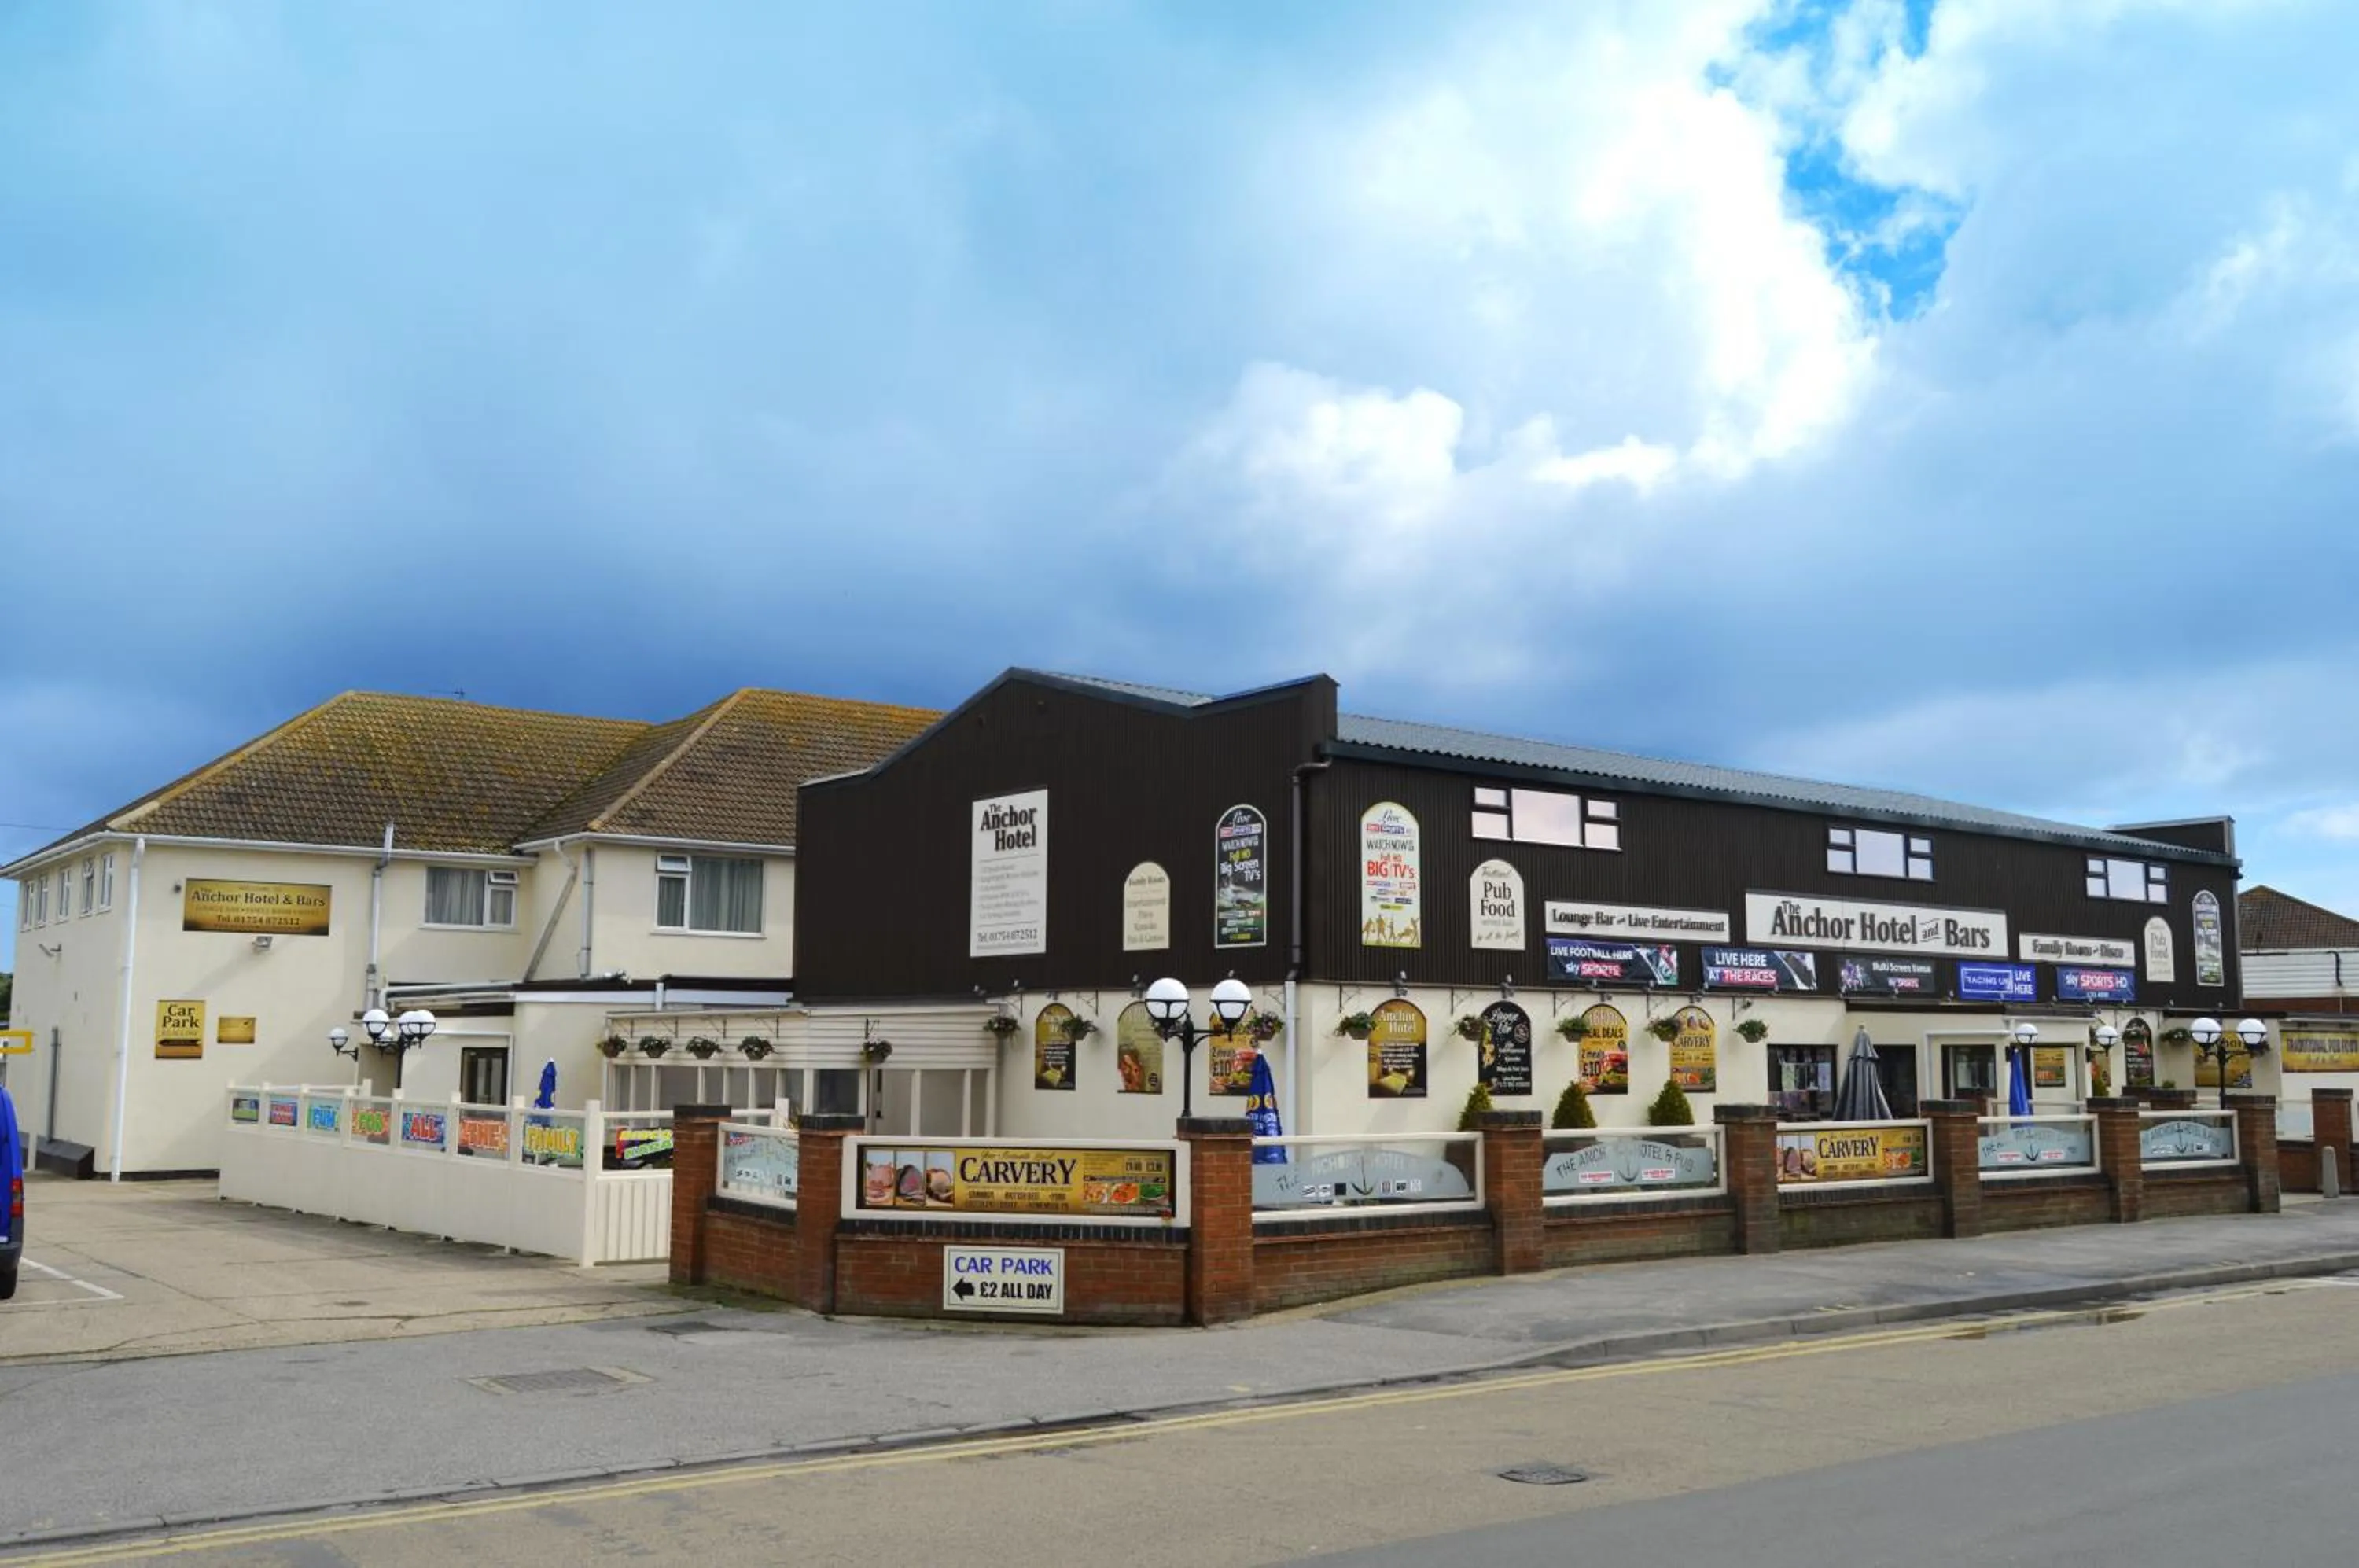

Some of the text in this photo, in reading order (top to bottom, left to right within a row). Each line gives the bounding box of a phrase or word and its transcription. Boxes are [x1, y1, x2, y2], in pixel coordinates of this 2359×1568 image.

[989, 803, 1002, 813] The
[981, 805, 1037, 831] Anchor
[995, 824, 1036, 852] Hotel
[1367, 861, 1415, 879] BIG TV's
[1484, 881, 1512, 900] Pub
[191, 890, 326, 907] Anchor Hotel & Bars
[1481, 899, 1515, 918] Food
[1781, 900, 1801, 914] The
[1552, 908, 1725, 932] Lounge Bar Live Entertainment
[1771, 906, 1990, 948] Anchor Hotel and Bars
[1551, 946, 1633, 960] LIVE FOOTBALL HERE
[2033, 939, 2063, 958] Family
[1715, 952, 1767, 967] LIVE HERE
[1566, 963, 1621, 977] sky SPORTS
[1890, 963, 1911, 973] Screen
[1708, 970, 1776, 984] AT THE RACES
[2015, 970, 2031, 982] LIVE
[2066, 974, 2128, 988] sky SPORTS HD
[2014, 985, 2033, 995] HERE
[168, 1004, 195, 1016] Car
[1378, 1010, 1415, 1021] Anchor
[163, 1015, 200, 1028] Park
[1389, 1021, 1416, 1032] Hotel
[1588, 1028, 1624, 1038] EAL DEALS
[1673, 1035, 1711, 1048] CARVERY
[1581, 1051, 1586, 1060] 2
[1213, 1060, 1231, 1076] £10
[1582, 1062, 1600, 1077] £10
[410, 1117, 438, 1140] ALL
[525, 1125, 579, 1156] FAMILY
[1819, 1136, 1879, 1159] CARVERY
[960, 1157, 1077, 1185] CARVERY
[1556, 1158, 1577, 1179] THE
[954, 1257, 1053, 1275] CAR PARK
[979, 1282, 1053, 1300] £2 ALL DAY
